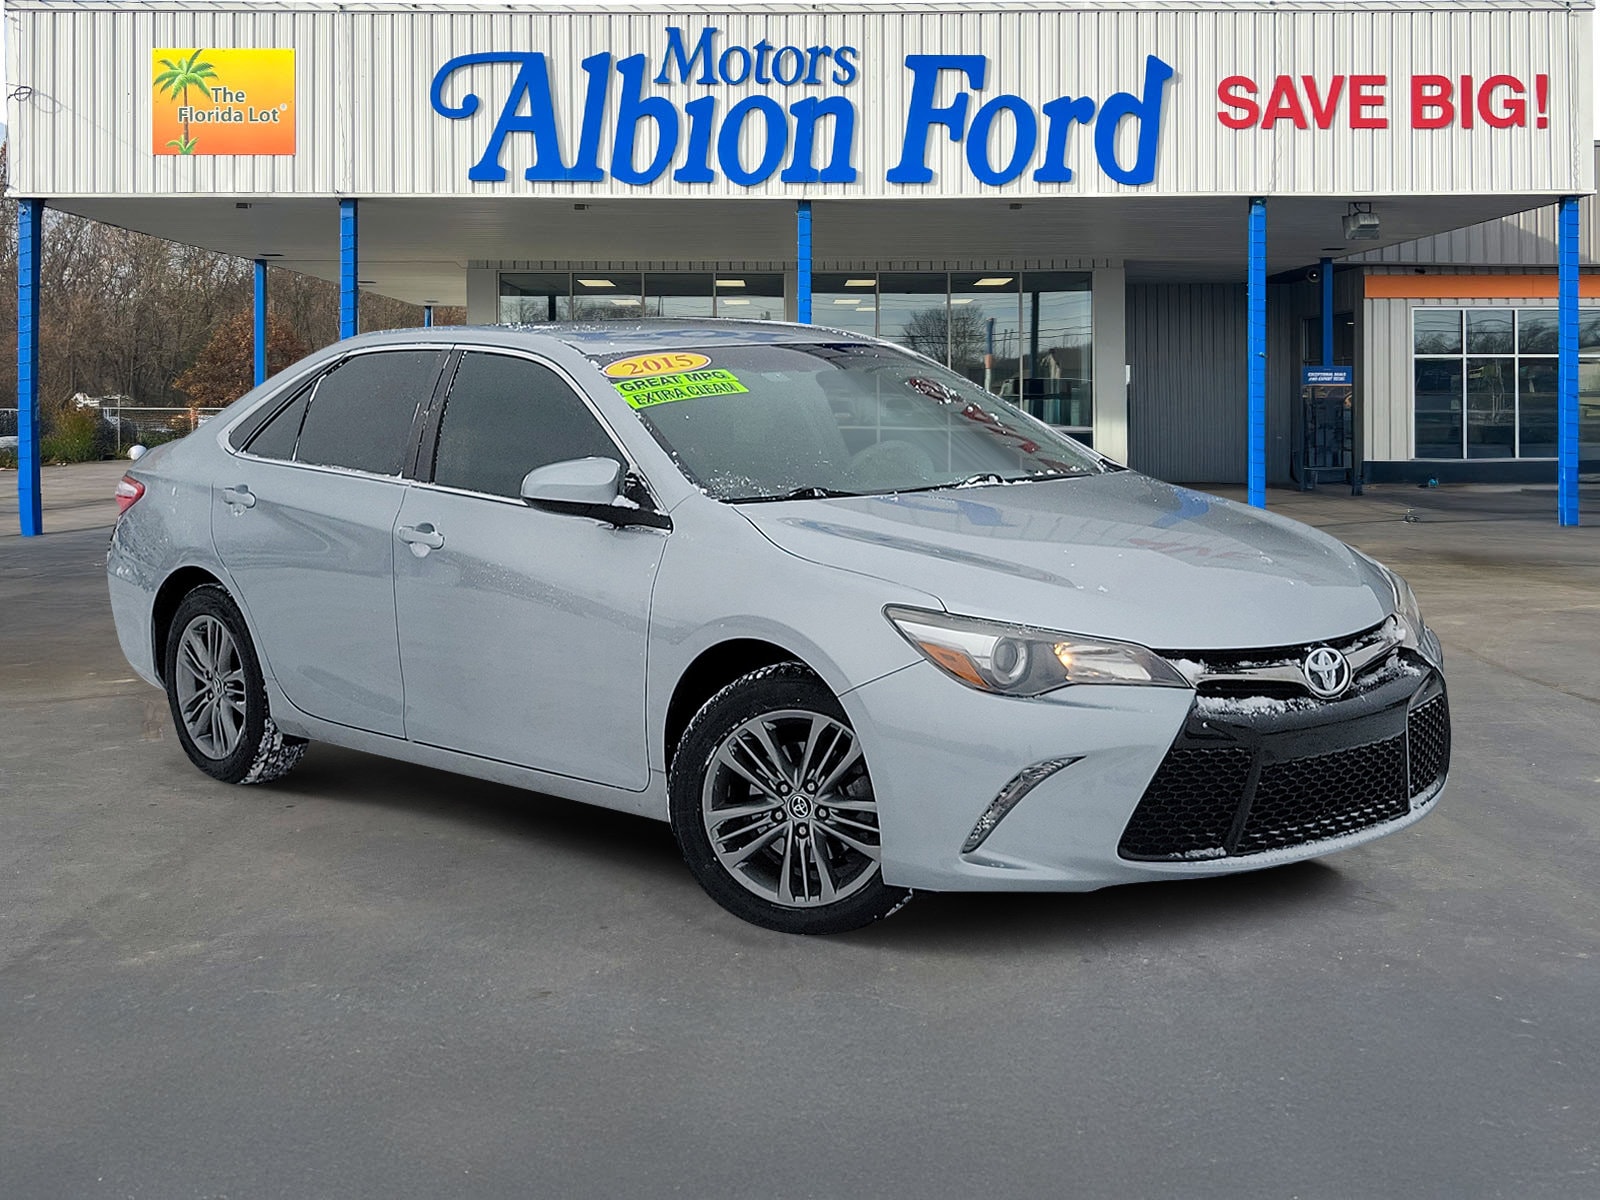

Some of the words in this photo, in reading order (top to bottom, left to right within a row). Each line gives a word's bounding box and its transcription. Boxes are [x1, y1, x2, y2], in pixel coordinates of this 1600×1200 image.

[655, 27, 856, 86] Motors
[211, 86, 246, 103] The
[1217, 75, 1388, 129] SAVE
[1411, 74, 1548, 130] BIG!
[178, 106, 243, 122] Florida
[249, 107, 279, 122] Lot
[431, 51, 857, 187] Albion
[886, 54, 1174, 187] Ford
[622, 355, 693, 375] 2015
[620, 375, 680, 392] GREAT
[684, 369, 726, 383] MPG
[633, 388, 685, 404] EXTRA
[688, 381, 738, 396] CLEAN
